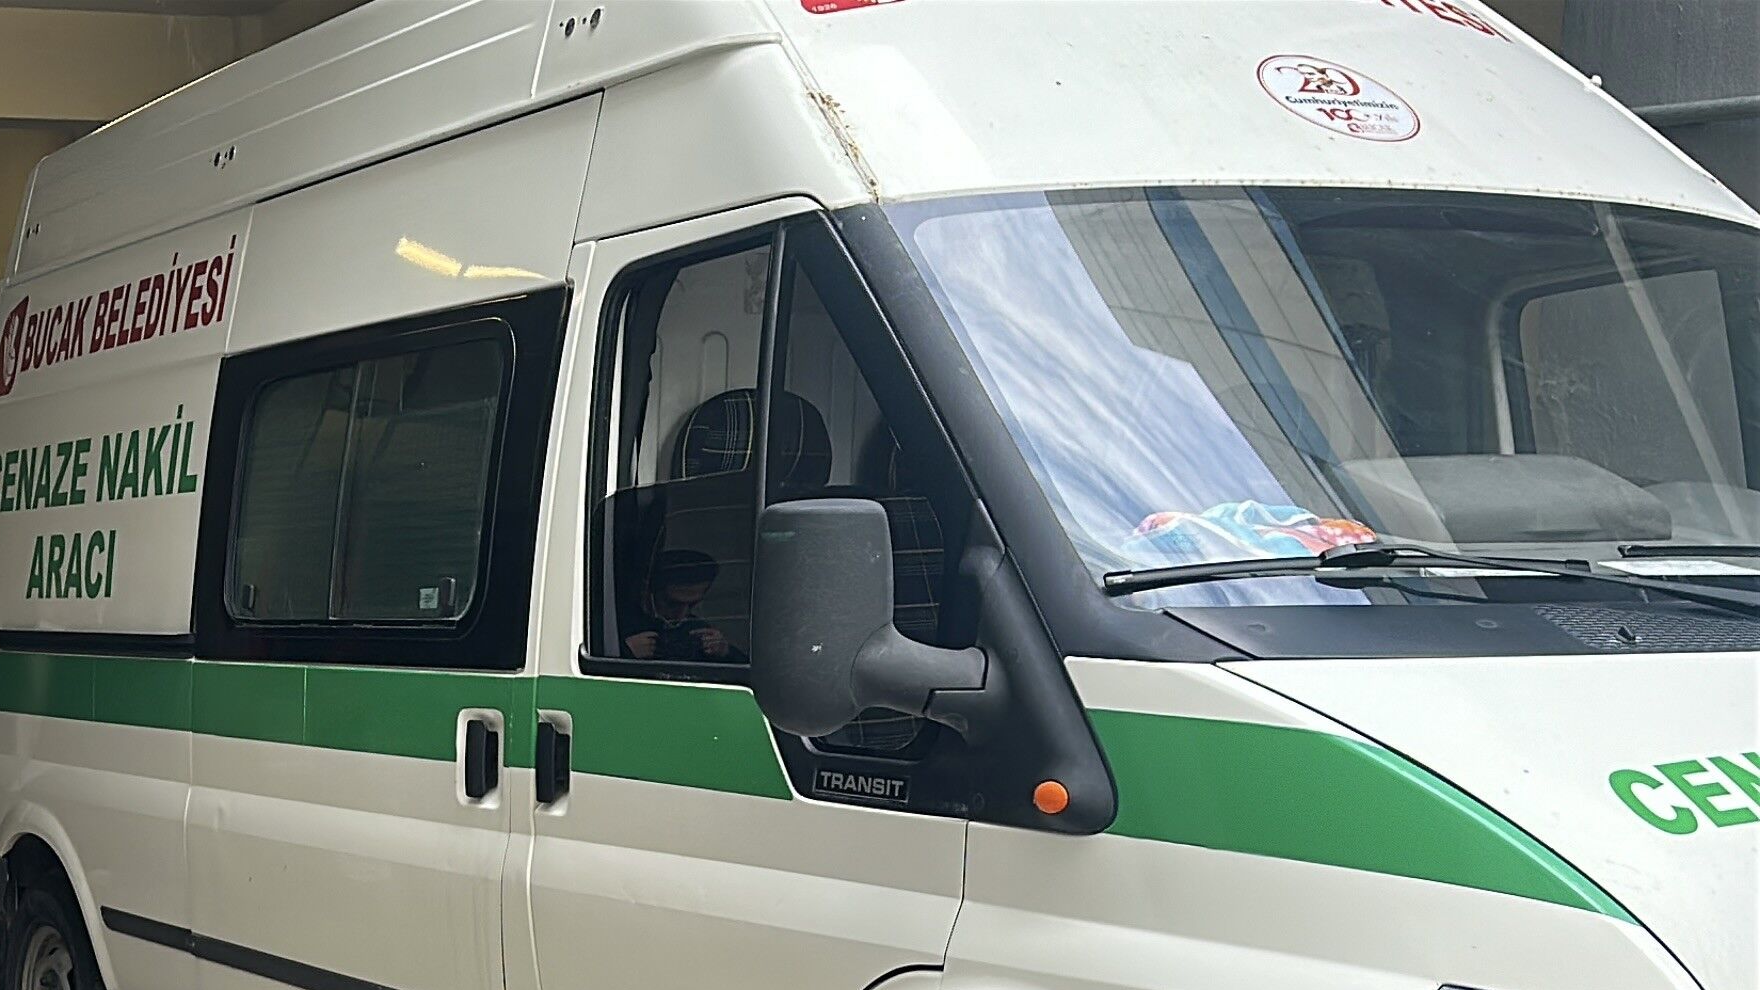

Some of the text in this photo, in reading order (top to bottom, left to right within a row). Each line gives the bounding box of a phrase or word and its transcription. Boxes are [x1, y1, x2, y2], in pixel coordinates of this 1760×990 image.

[20, 234, 237, 373] BUCAK BELEDİYESİ
[96, 404, 198, 503] NAKİL
[26, 529, 117, 600] ARACI
[820, 771, 904, 797] TRANSIT
